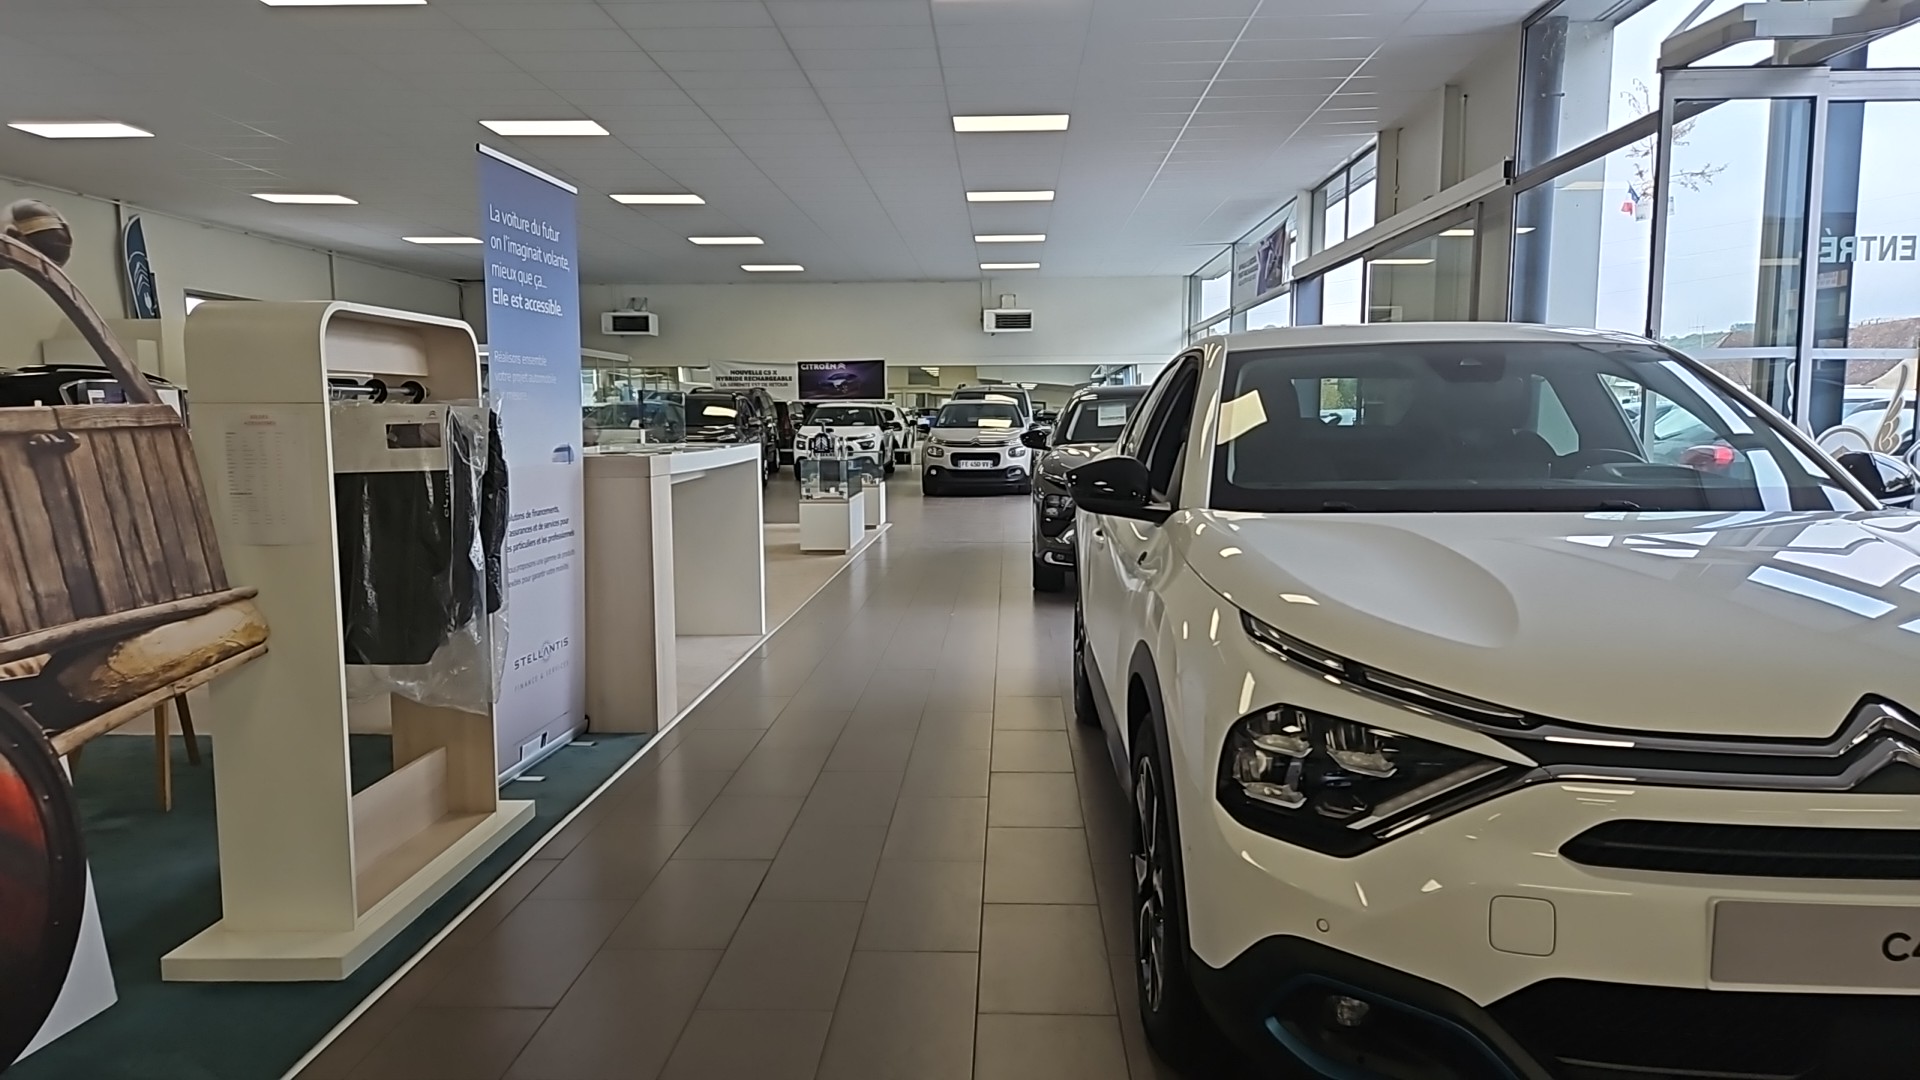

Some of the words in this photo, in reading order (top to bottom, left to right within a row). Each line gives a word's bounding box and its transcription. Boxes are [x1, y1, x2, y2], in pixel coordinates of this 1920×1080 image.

[489, 203, 500, 223] La
[502, 211, 530, 233] voiture
[531, 218, 541, 236] du
[542, 221, 560, 242] futur
[490, 235, 501, 250] on
[503, 234, 542, 262] l'imaginait
[543, 250, 570, 272] volante,
[491, 262, 516, 280] mieux
[517, 270, 533, 287] que
[492, 287, 509, 306] Elle
[510, 293, 523, 309] est
[524, 298, 563, 317] accessible.
[514, 636, 569, 671] STELLANTIS
